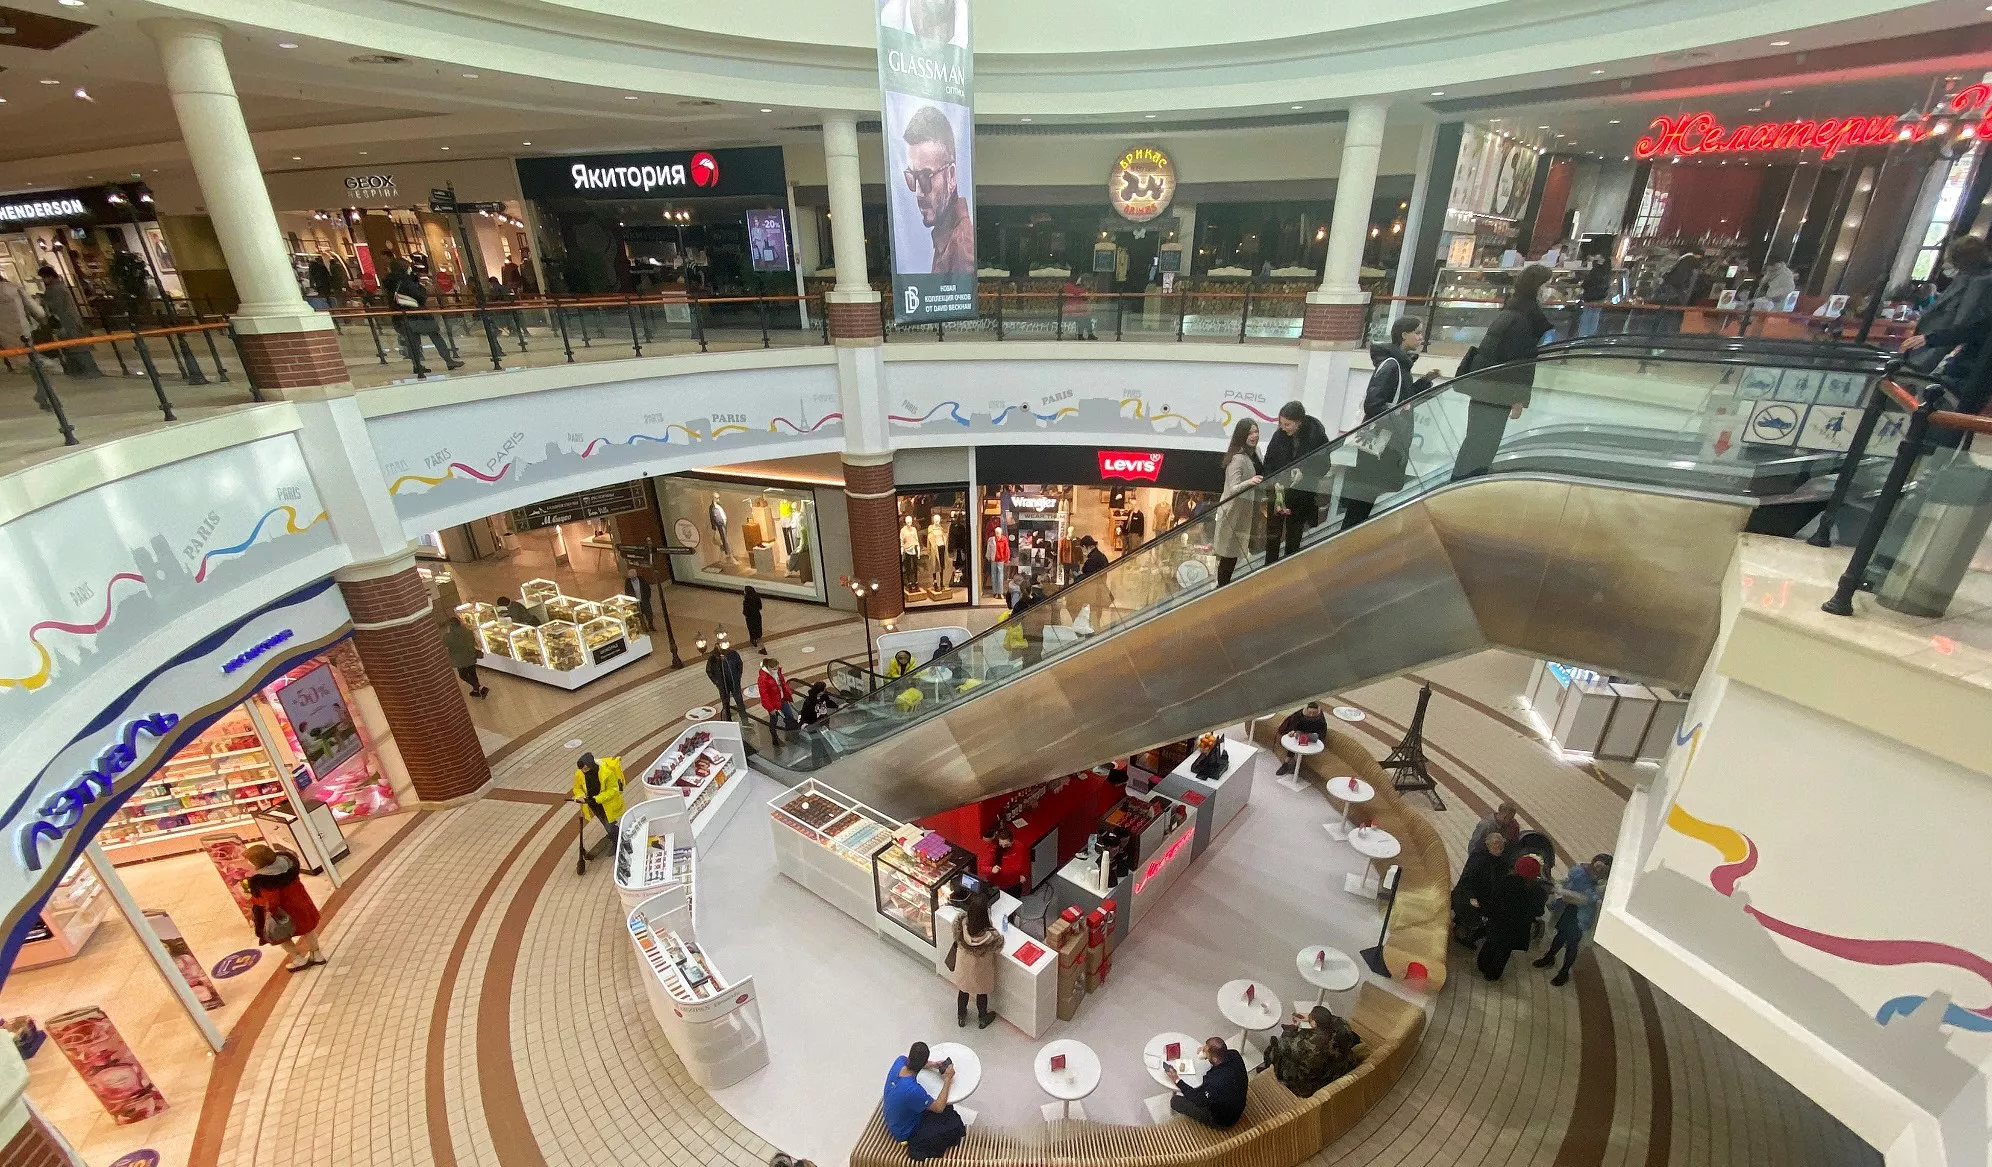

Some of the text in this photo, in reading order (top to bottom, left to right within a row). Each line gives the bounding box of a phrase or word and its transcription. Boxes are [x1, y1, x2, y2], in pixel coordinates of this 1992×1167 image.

[888, 50, 965, 87] GLASSMAN
[345, 175, 396, 190] GEOX
[571, 164, 686, 192] Якитория
[0, 199, 84, 220] HENDERSON
[939, 284, 957, 292] НОВАЯ
[924, 293, 972, 303] КОЛЛЕКЦИЯ ОЧКОВ
[933, 304, 948, 312] DAVID
[948, 303, 972, 311] BECKHAM
[1041, 388, 1074, 406] PARIS
[1224, 389, 1267, 404] PARIS
[711, 412, 748, 425] PARIS
[424, 447, 453, 470] PARIS
[485, 430, 526, 474] PARIS
[276, 486, 302, 501] PARIS
[1011, 496, 1057, 512] Wrangler
[182, 510, 222, 560] PARIS
